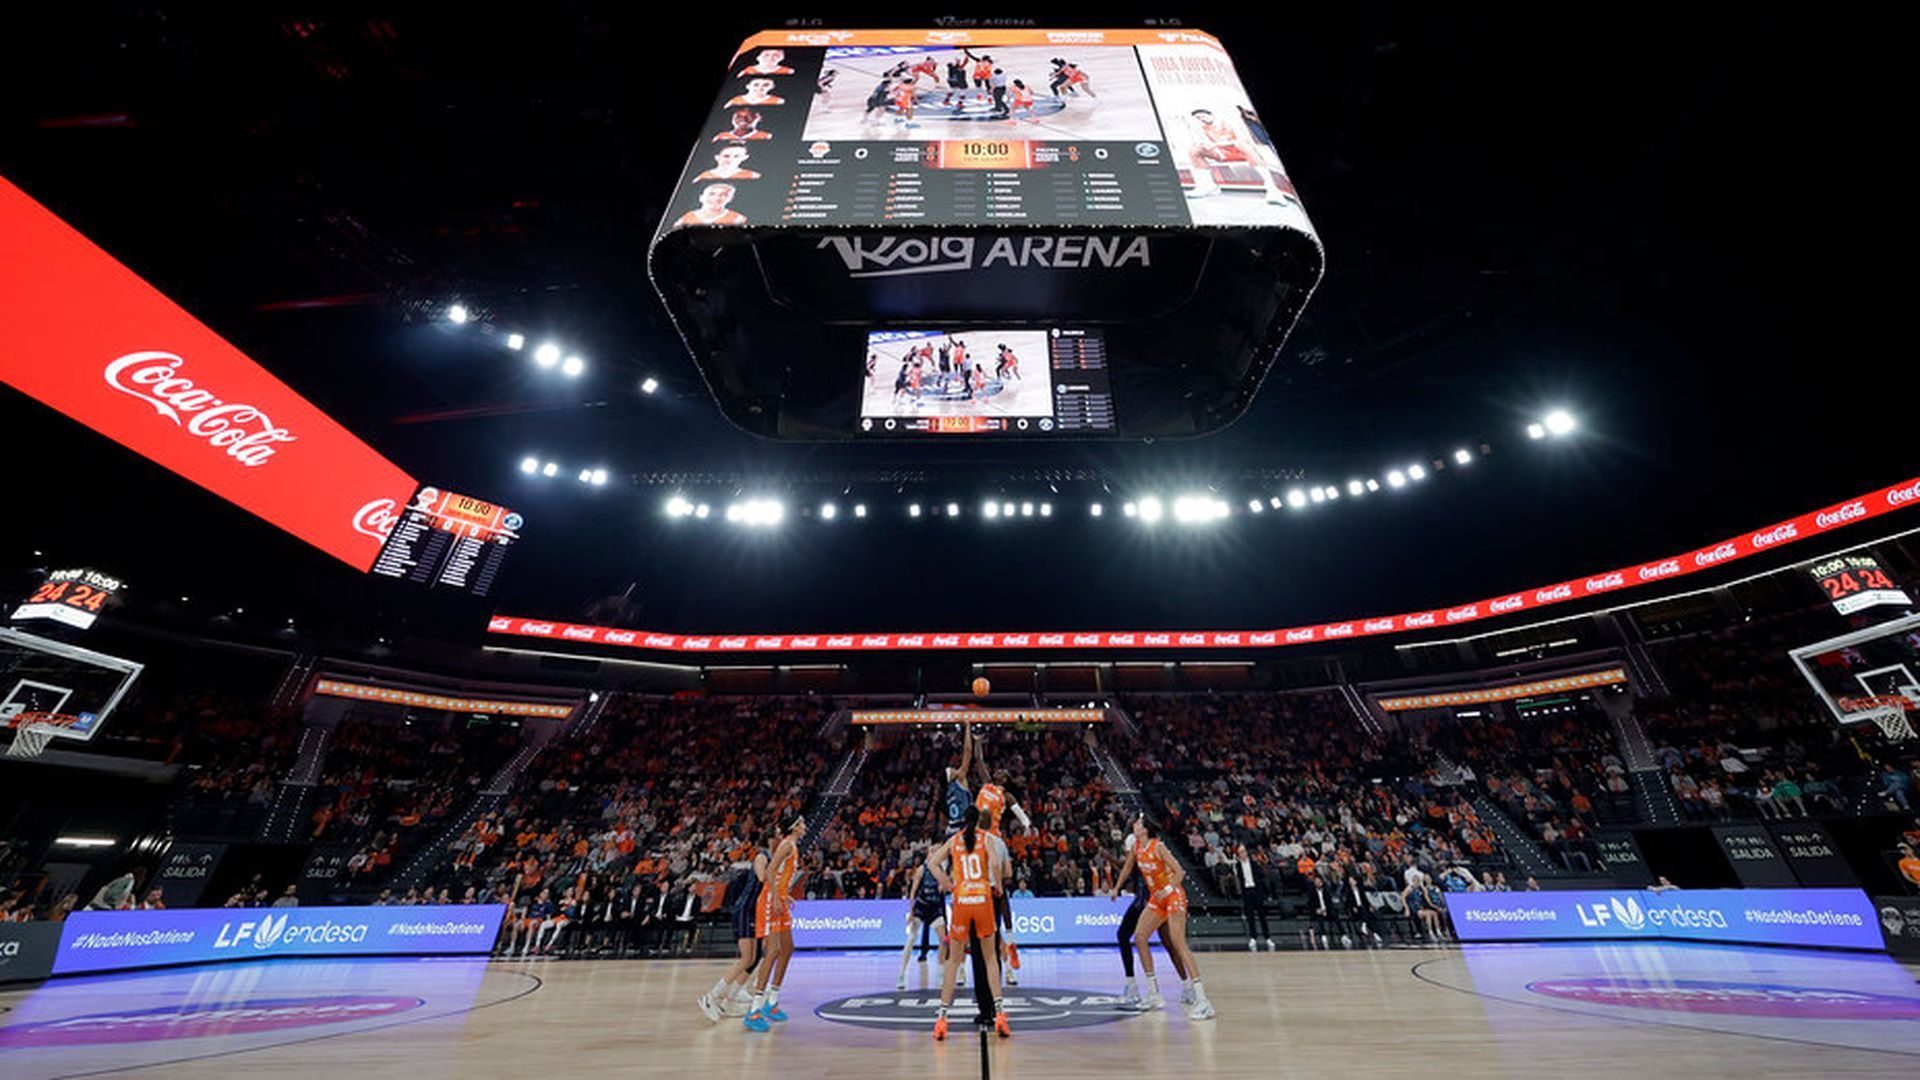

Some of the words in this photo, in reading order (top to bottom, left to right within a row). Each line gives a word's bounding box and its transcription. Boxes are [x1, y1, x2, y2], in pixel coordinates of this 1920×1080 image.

[964, 142, 1009, 156] 10:00
[981, 236, 1151, 268] ARENA
[104, 351, 298, 467] Coca-Cola
[458, 497, 492, 516] 10:00
[84, 571, 119, 591] 10:00
[1811, 559, 1845, 578] 10:00
[29, 581, 70, 603] 24
[66, 585, 108, 611] 24
[1823, 572, 1860, 599] 24
[1858, 570, 1894, 588] 24
[163, 866, 207, 878] SALIDA
[306, 868, 338, 878] SALID
[960, 853, 982, 880] 10
[1465, 908, 1557, 923] #NadaNosDetiene
[1576, 904, 1612, 927] LF
[1647, 905, 1728, 929] endesa
[1745, 908, 1864, 928] #NadaNosDetiene
[71, 929, 196, 950] #NadaNosDetiene
[214, 922, 255, 948] LF
[283, 920, 368, 943] endesa
[388, 921, 486, 936] #NadaNosDetiene
